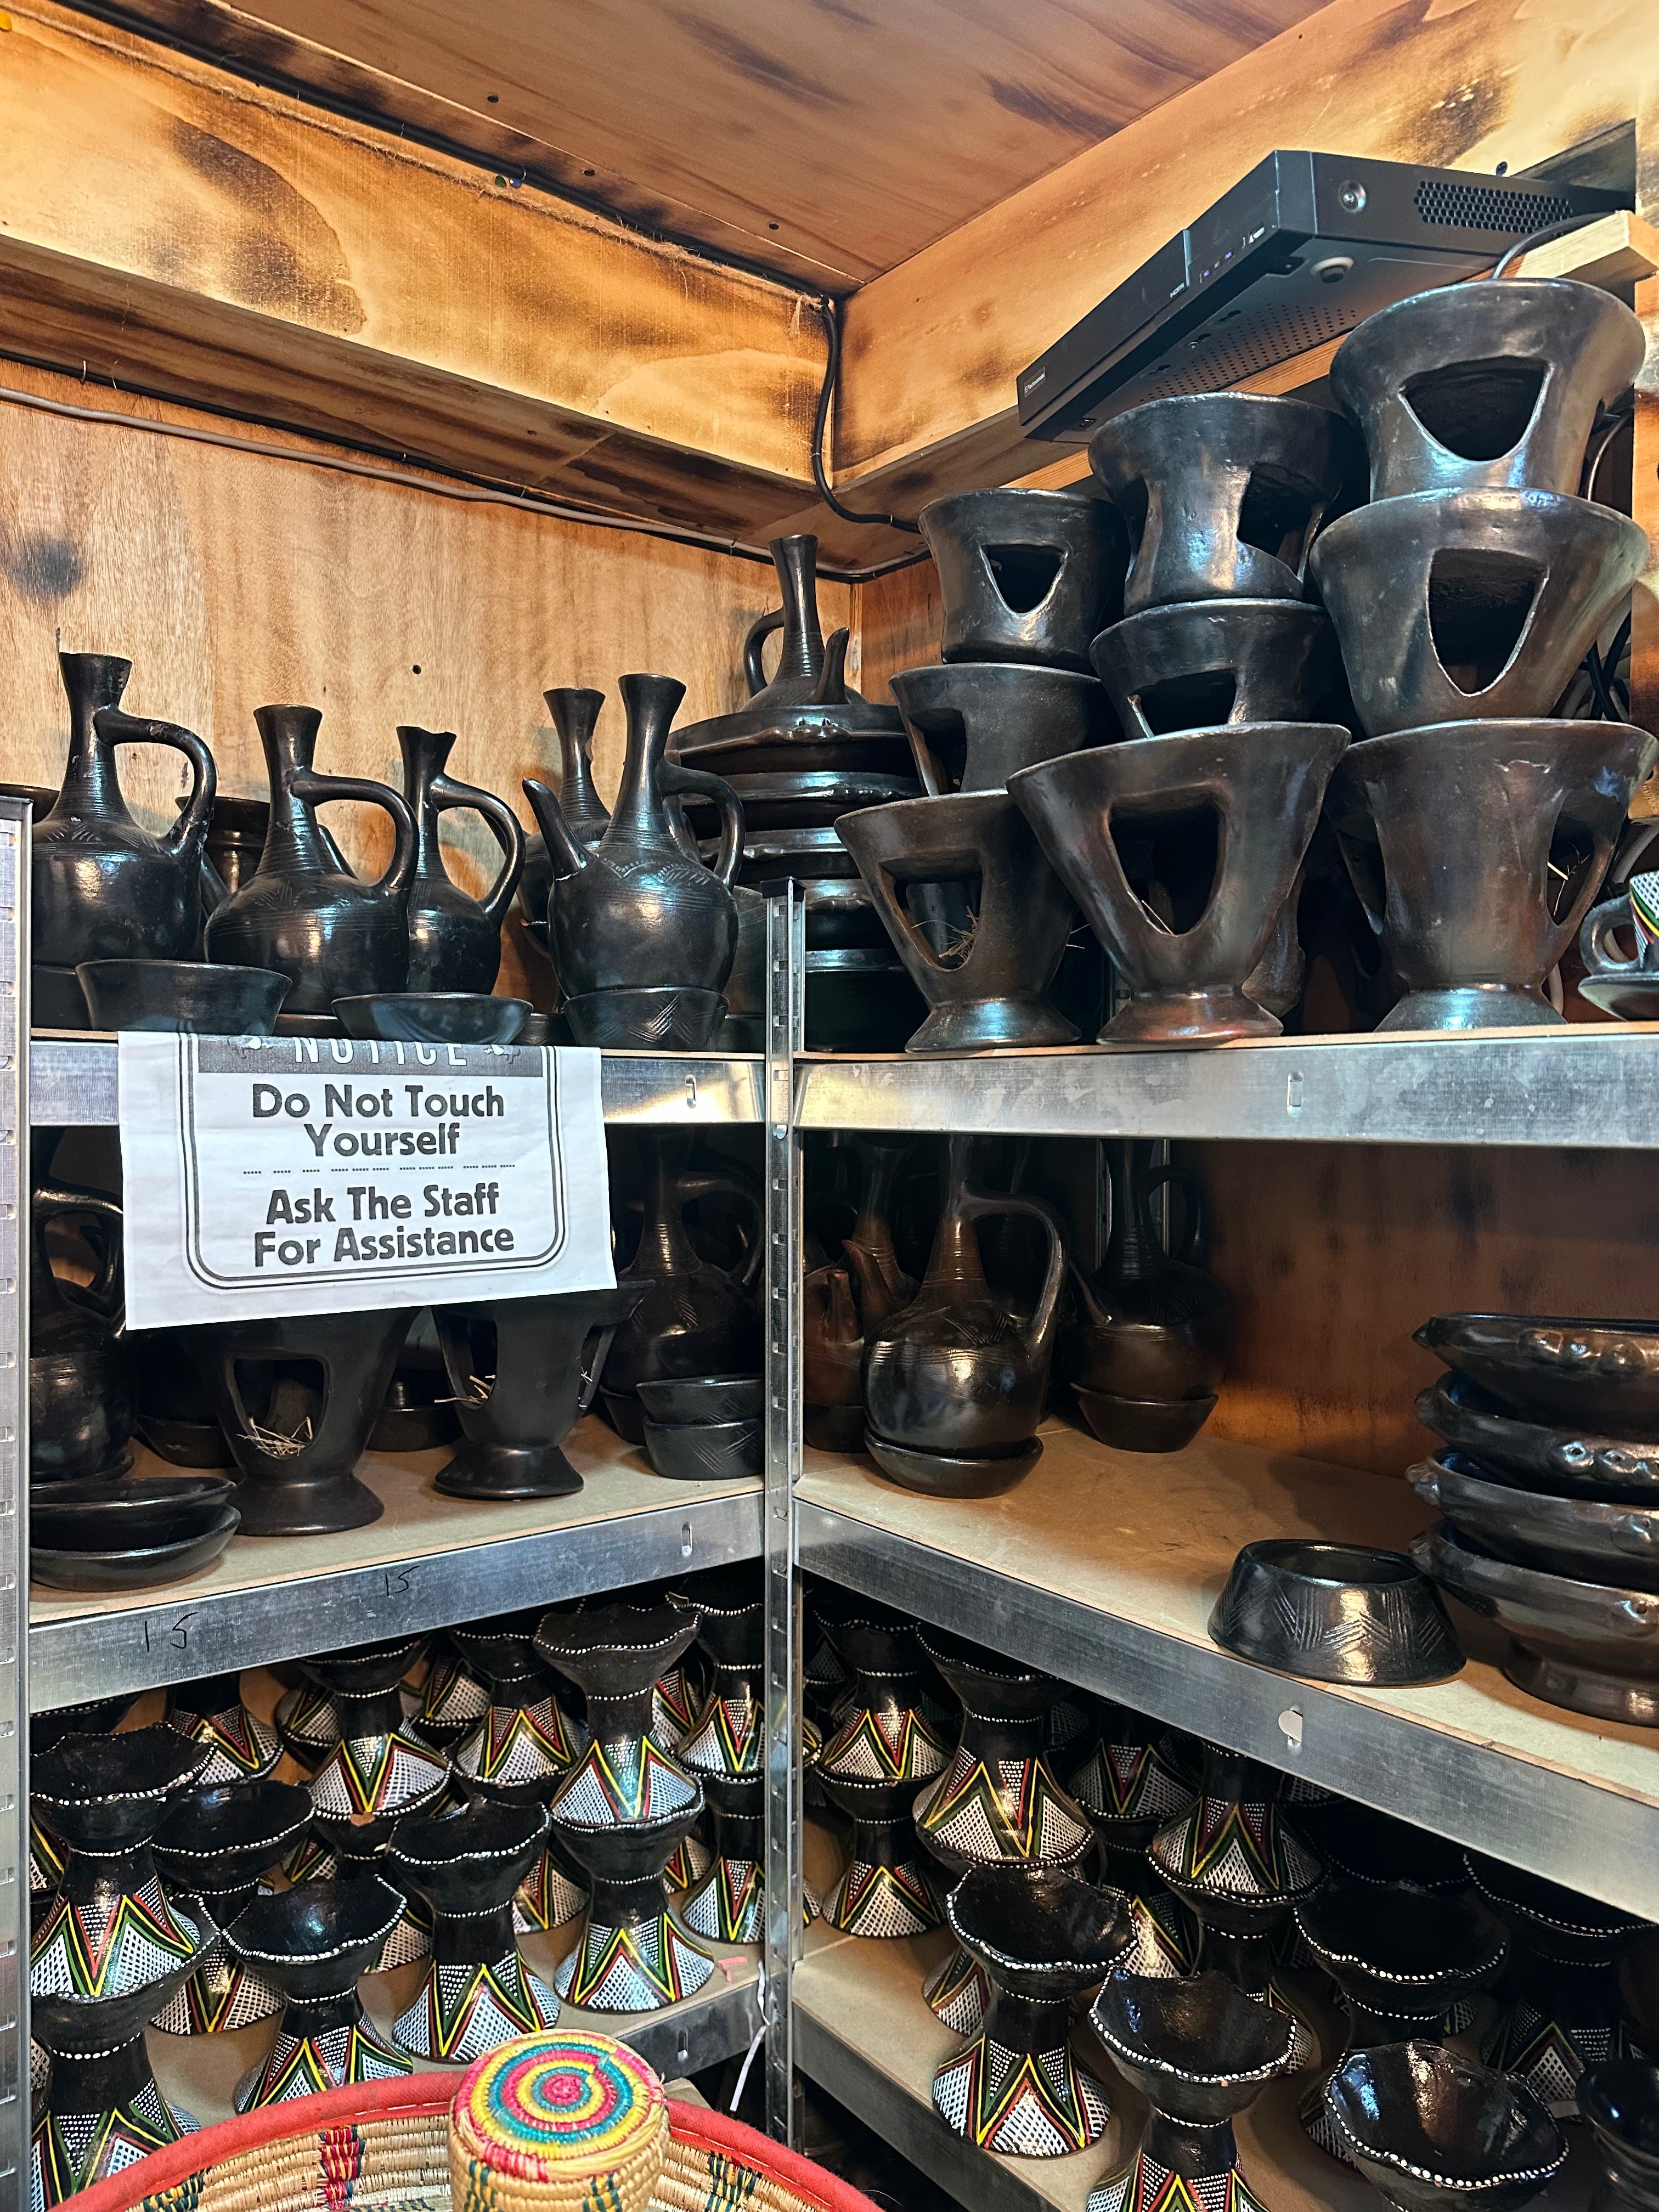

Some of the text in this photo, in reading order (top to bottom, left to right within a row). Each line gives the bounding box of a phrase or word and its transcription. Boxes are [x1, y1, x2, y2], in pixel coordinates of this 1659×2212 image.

[252, 1083, 505, 1118] Do Not Touch
[303, 1122, 460, 1157] Yourself
[266, 1182, 500, 1225] Ask The Staff
[254, 1226, 515, 1268] For Assistance
[385, 1565, 421, 1596] 15
